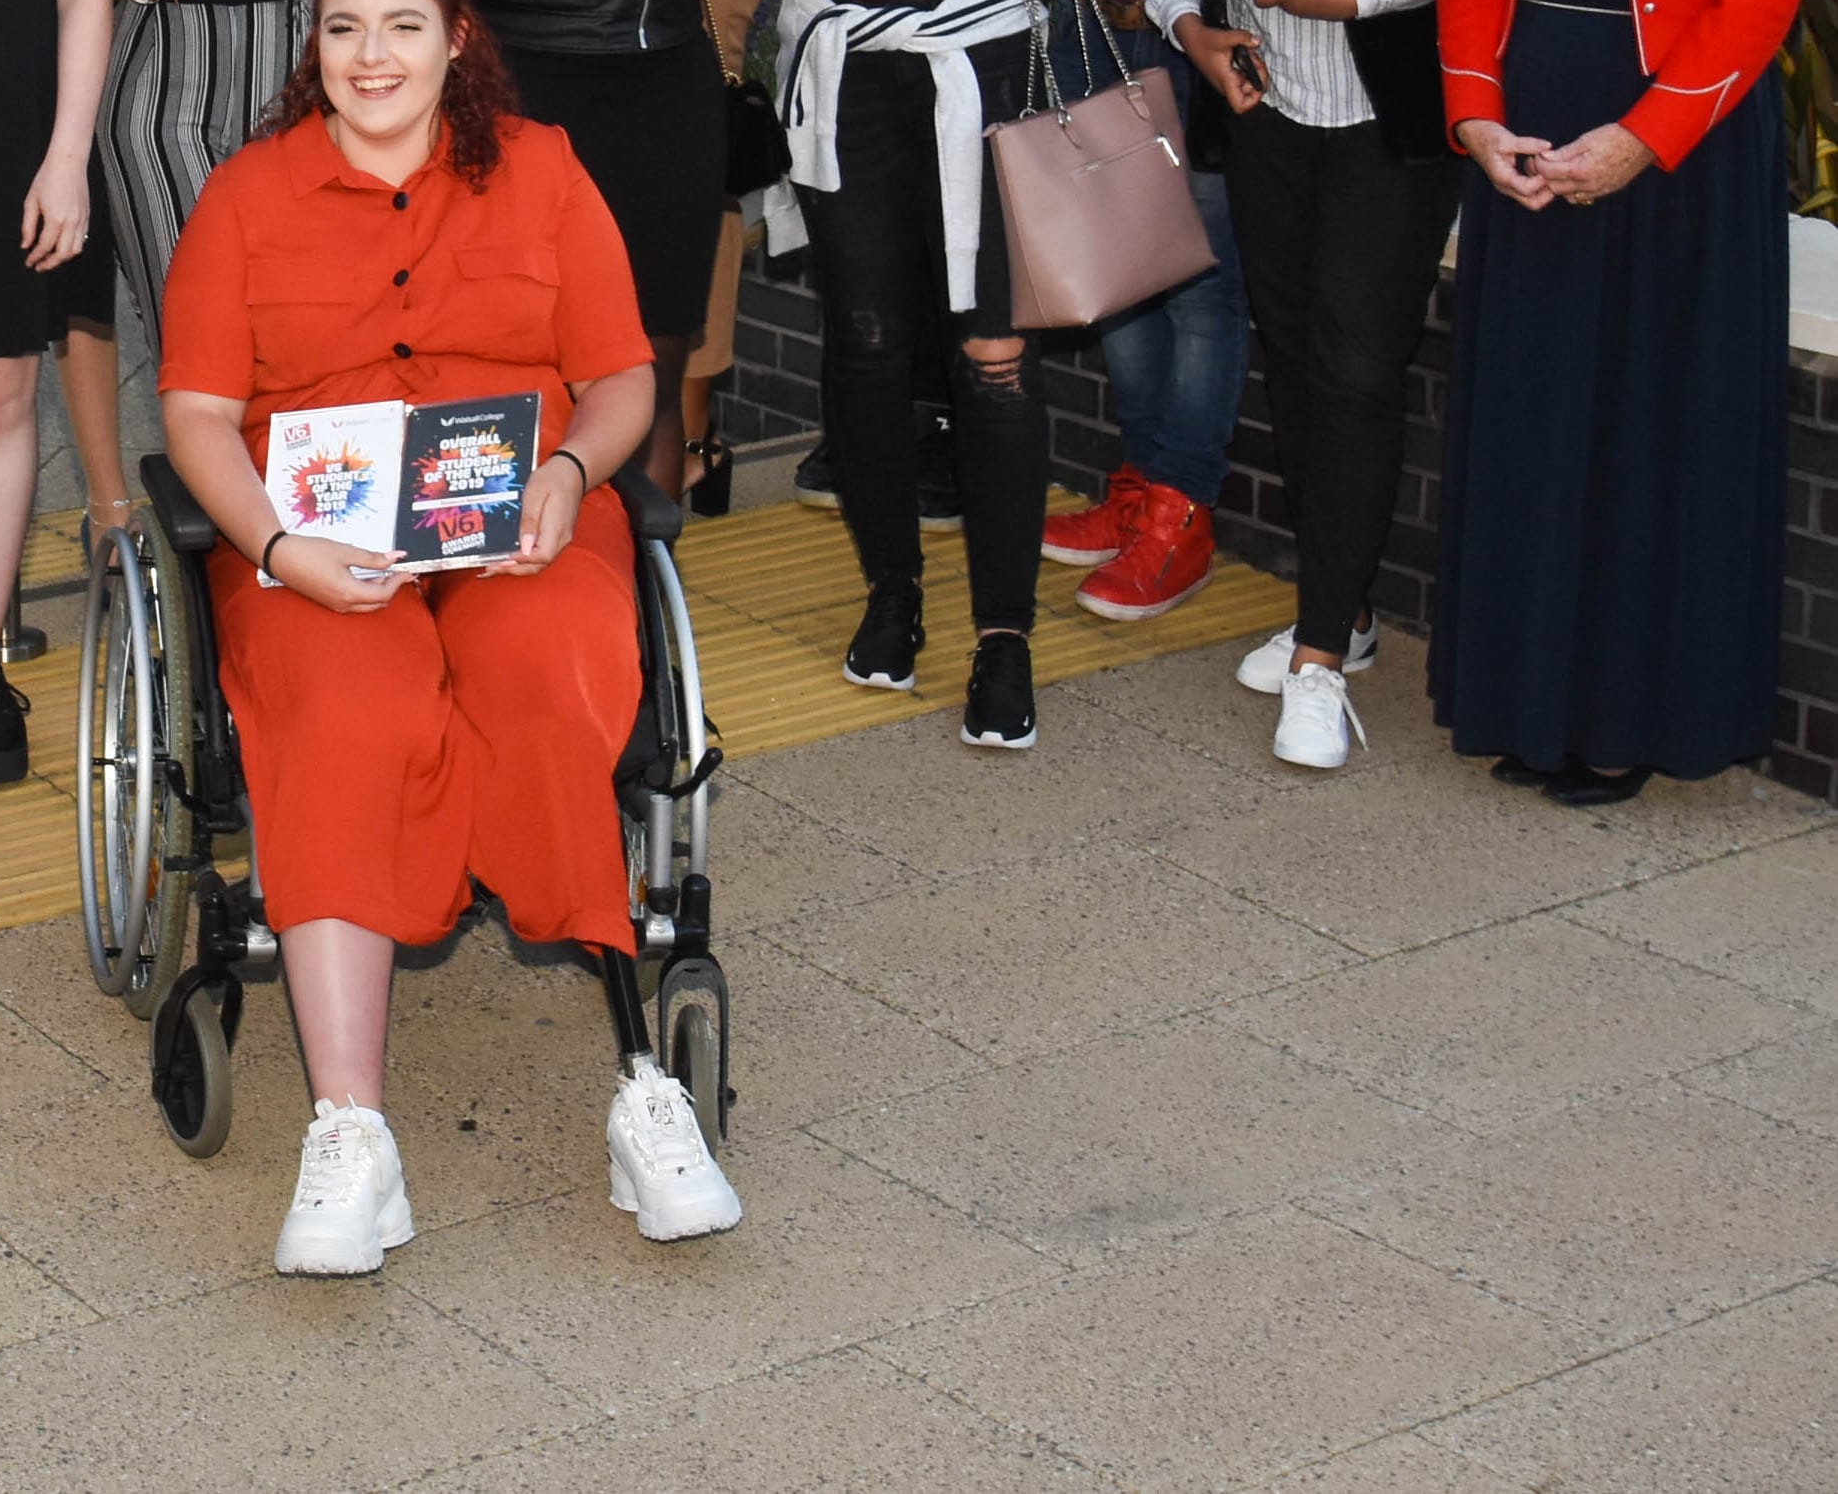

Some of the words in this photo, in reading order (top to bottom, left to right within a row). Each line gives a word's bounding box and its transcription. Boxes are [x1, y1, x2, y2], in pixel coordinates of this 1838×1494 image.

[284, 425, 308, 442] V6
[440, 433, 501, 450] OVERALL
[459, 447, 479, 458] V6
[437, 454, 500, 471] STUDENT
[306, 471, 359, 486] STUDENT
[424, 471, 443, 483] OF
[444, 468, 471, 481] THE
[473, 464, 511, 477] YEAR
[312, 484, 326, 494] OF
[330, 481, 353, 493] THE
[449, 477, 485, 491] 2019
[316, 491, 348, 503] YEAR
[315, 501, 347, 512] 2019
[441, 513, 476, 538] V6
